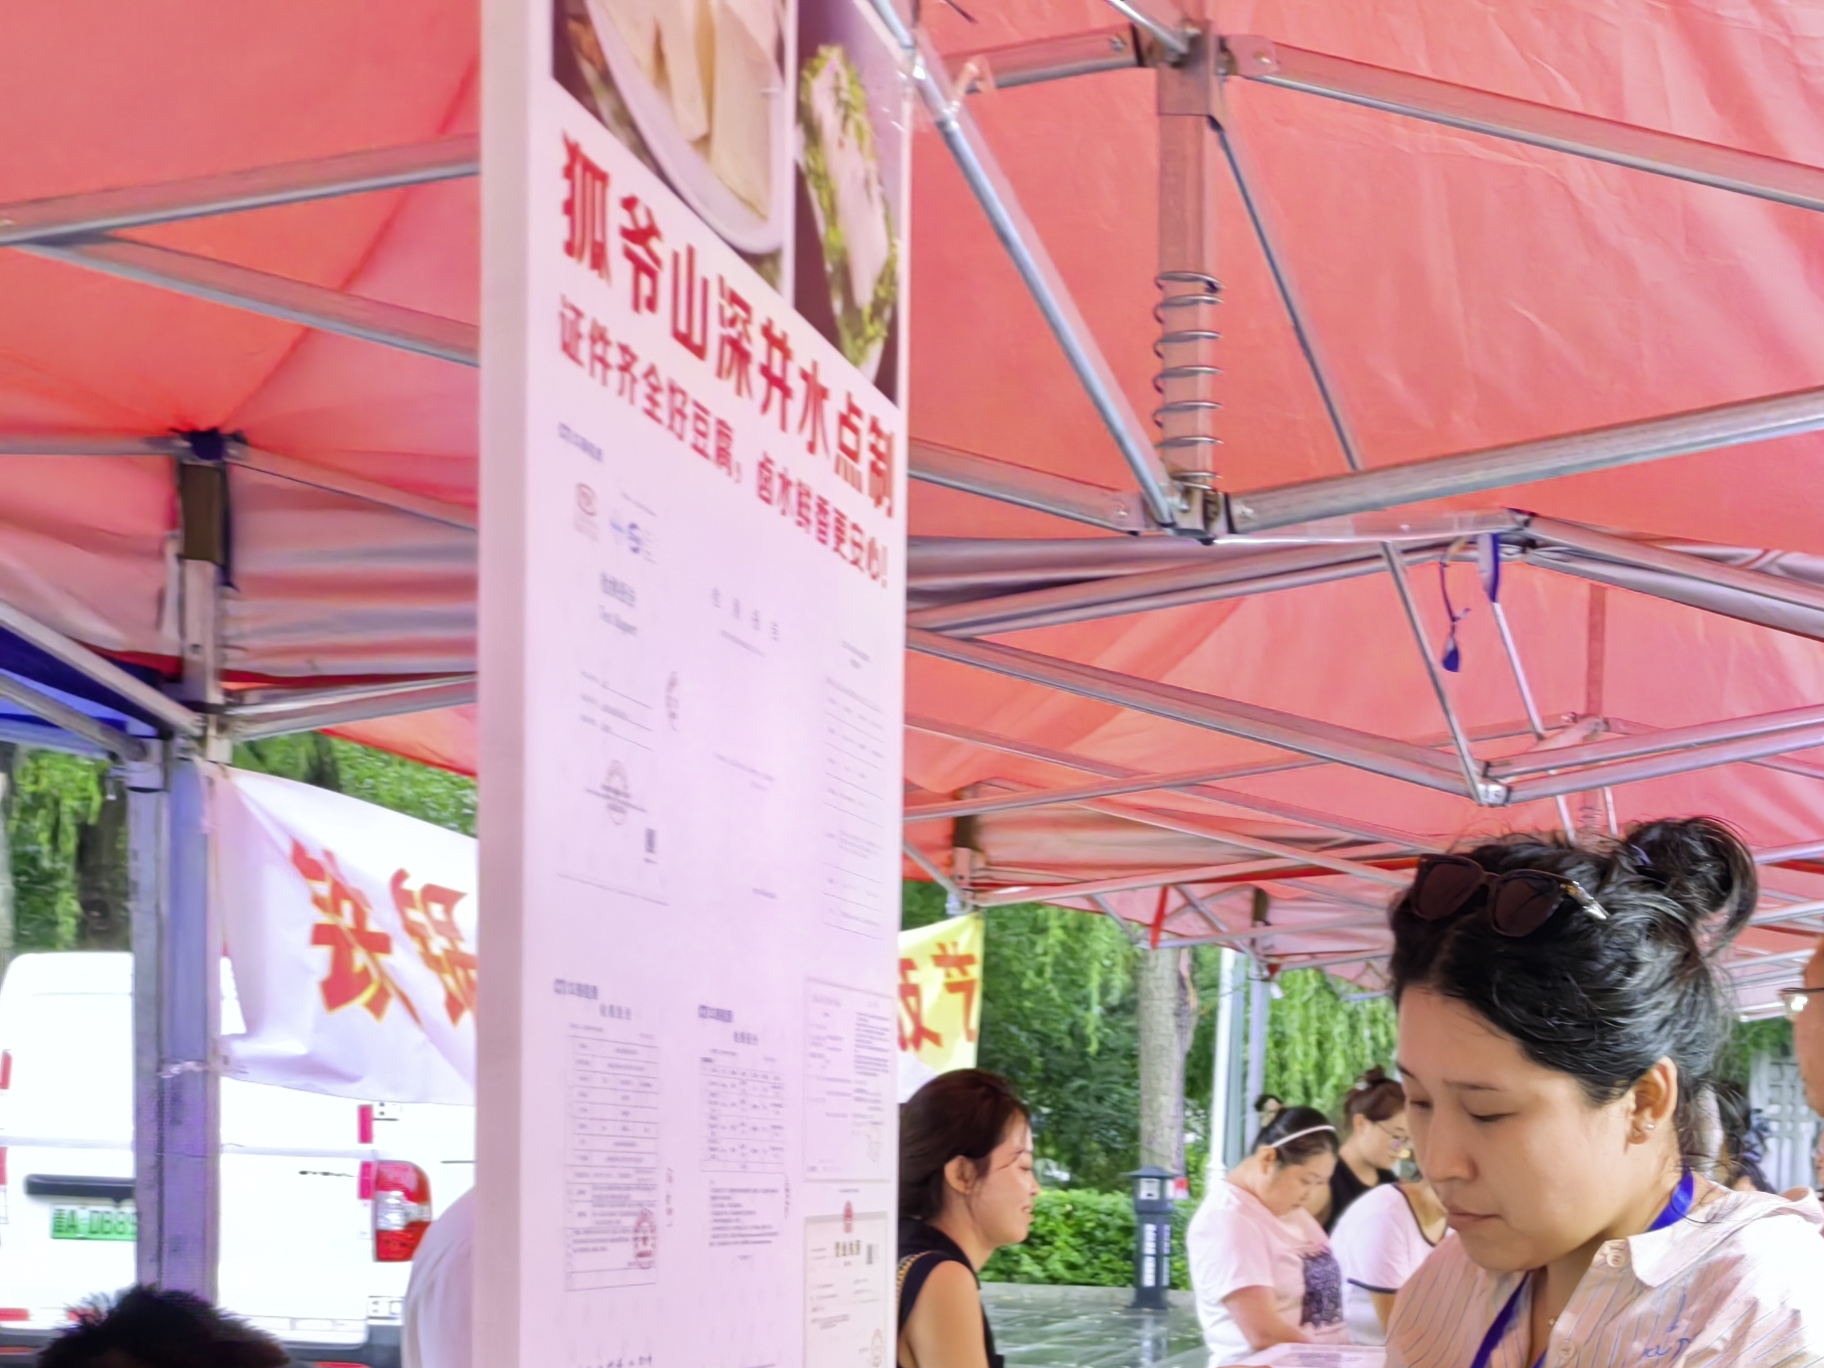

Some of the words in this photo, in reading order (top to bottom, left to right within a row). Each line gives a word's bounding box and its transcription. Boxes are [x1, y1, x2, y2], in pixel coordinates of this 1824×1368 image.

[562, 128, 895, 518] 狐爷山深井水点制
